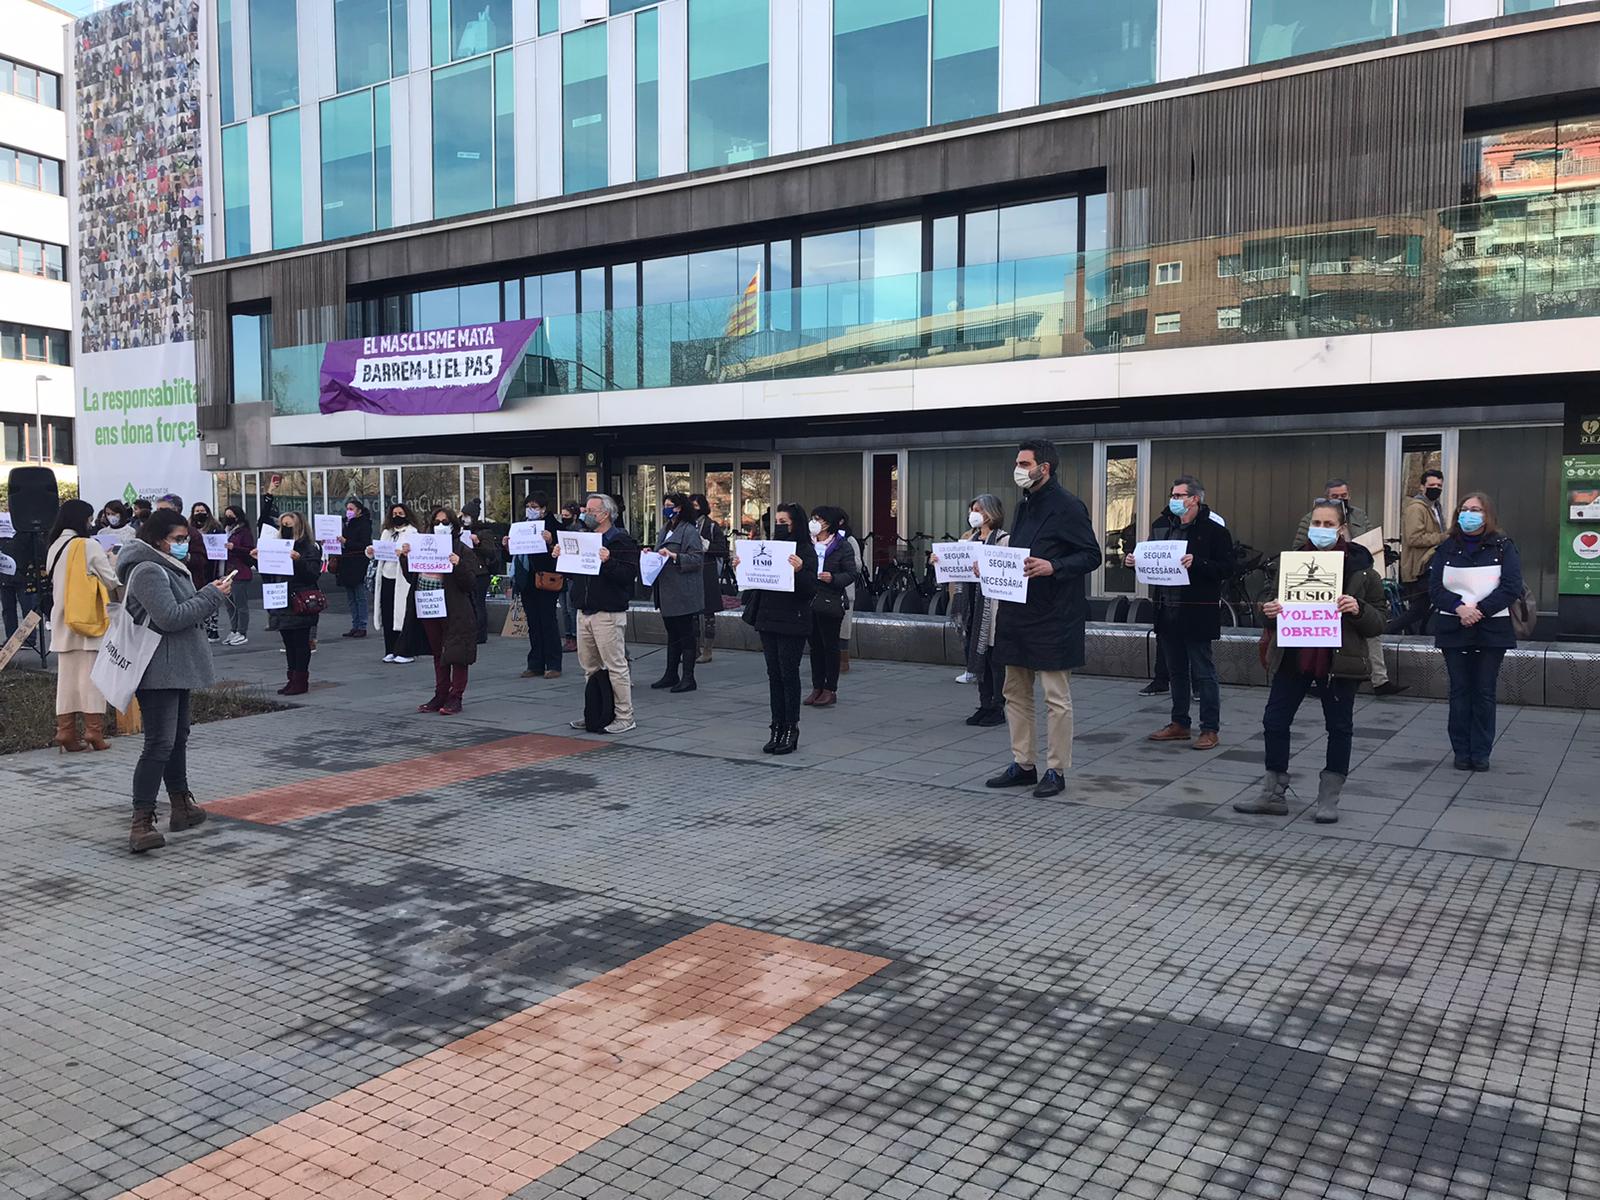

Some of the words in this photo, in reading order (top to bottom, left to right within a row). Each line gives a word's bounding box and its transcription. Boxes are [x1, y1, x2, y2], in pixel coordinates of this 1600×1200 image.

[363, 337, 378, 355] EL
[380, 329, 455, 353] MASCLISME
[458, 326, 494, 346] MATA
[444, 357, 462, 379] EL
[464, 354, 493, 377] PAS
[83, 387, 99, 411] La
[95, 425, 119, 445] ens
[121, 419, 153, 444] dona
[156, 416, 196, 448] força
[943, 552, 971, 560] SEGURA
[984, 549, 993, 557] La
[995, 550, 1013, 559] cultura
[1143, 551, 1172, 560] SEGURA
[988, 558, 1017, 570] SEGURA
[1138, 566, 1182, 575] NECESSÀRIA
[981, 576, 1023, 589] NECESSÀRIA
[1280, 609, 1339, 620] VOLEM
[1281, 626, 1338, 637] OBRIR!
